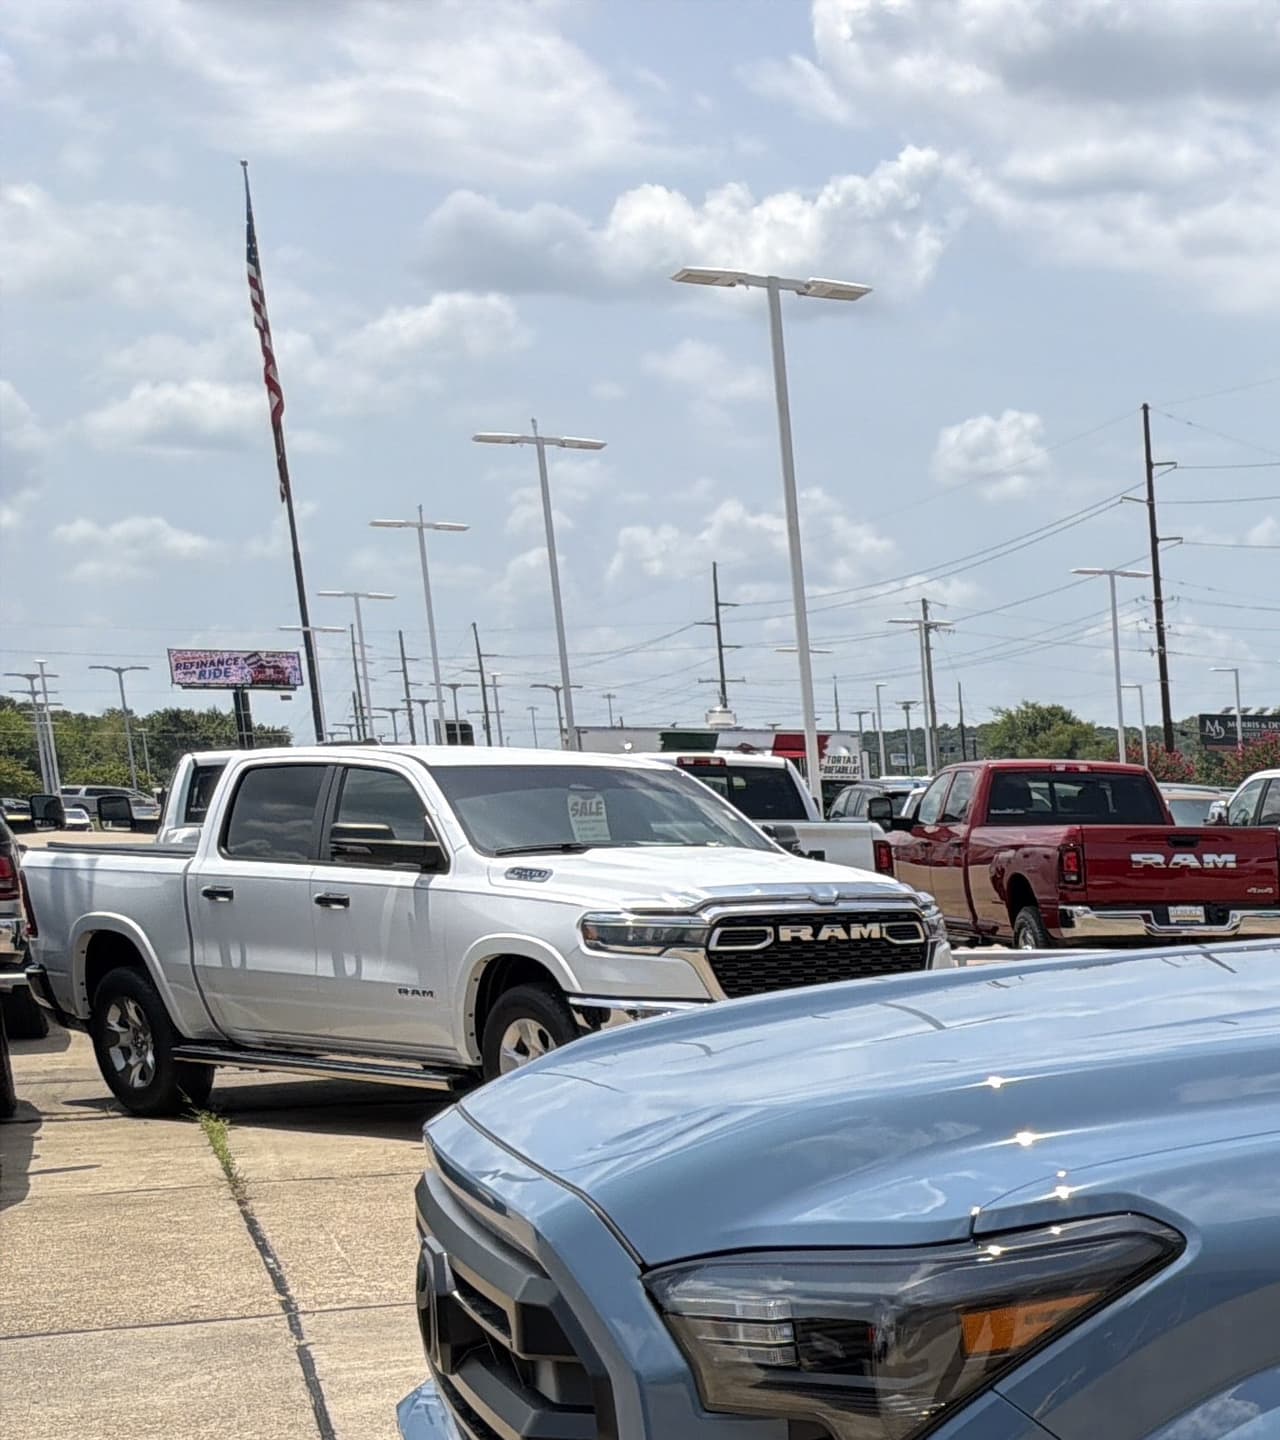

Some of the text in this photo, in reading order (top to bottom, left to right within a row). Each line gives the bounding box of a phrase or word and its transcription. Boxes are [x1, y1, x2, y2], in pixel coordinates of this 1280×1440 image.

[174, 656, 241, 671] REFINANCE
[197, 668, 231, 680] RIDE
[827, 755, 857, 764] TORTAS
[570, 801, 603, 817] SALE
[1130, 854, 1237, 868] RAM
[779, 923, 881, 941] RAM
[398, 988, 433, 998] RAM
